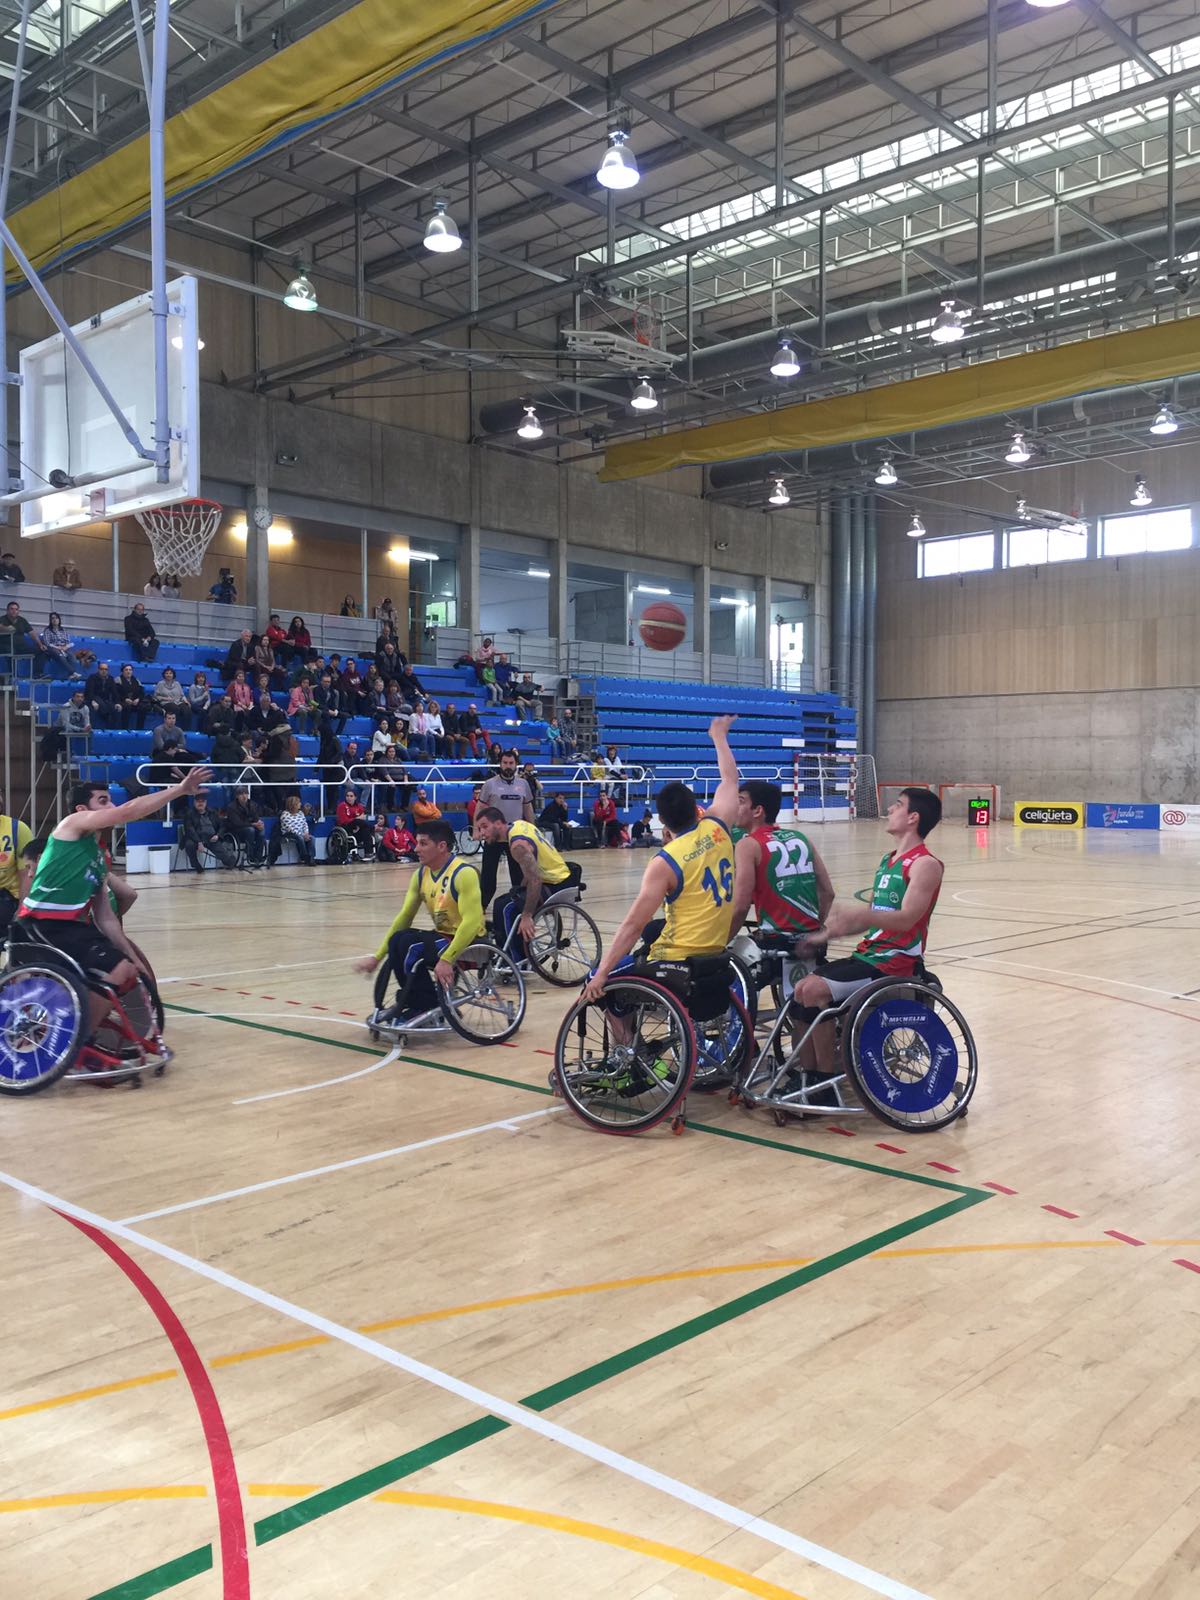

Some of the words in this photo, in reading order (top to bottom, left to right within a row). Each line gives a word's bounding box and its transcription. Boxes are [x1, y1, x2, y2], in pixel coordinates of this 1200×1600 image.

[976, 811, 988, 824] 13
[1025, 809, 1073, 823] celigüeta
[766, 838, 814, 877] 22
[702, 857, 733, 907] 16
[926, 1055, 943, 1095] MICHELIN
